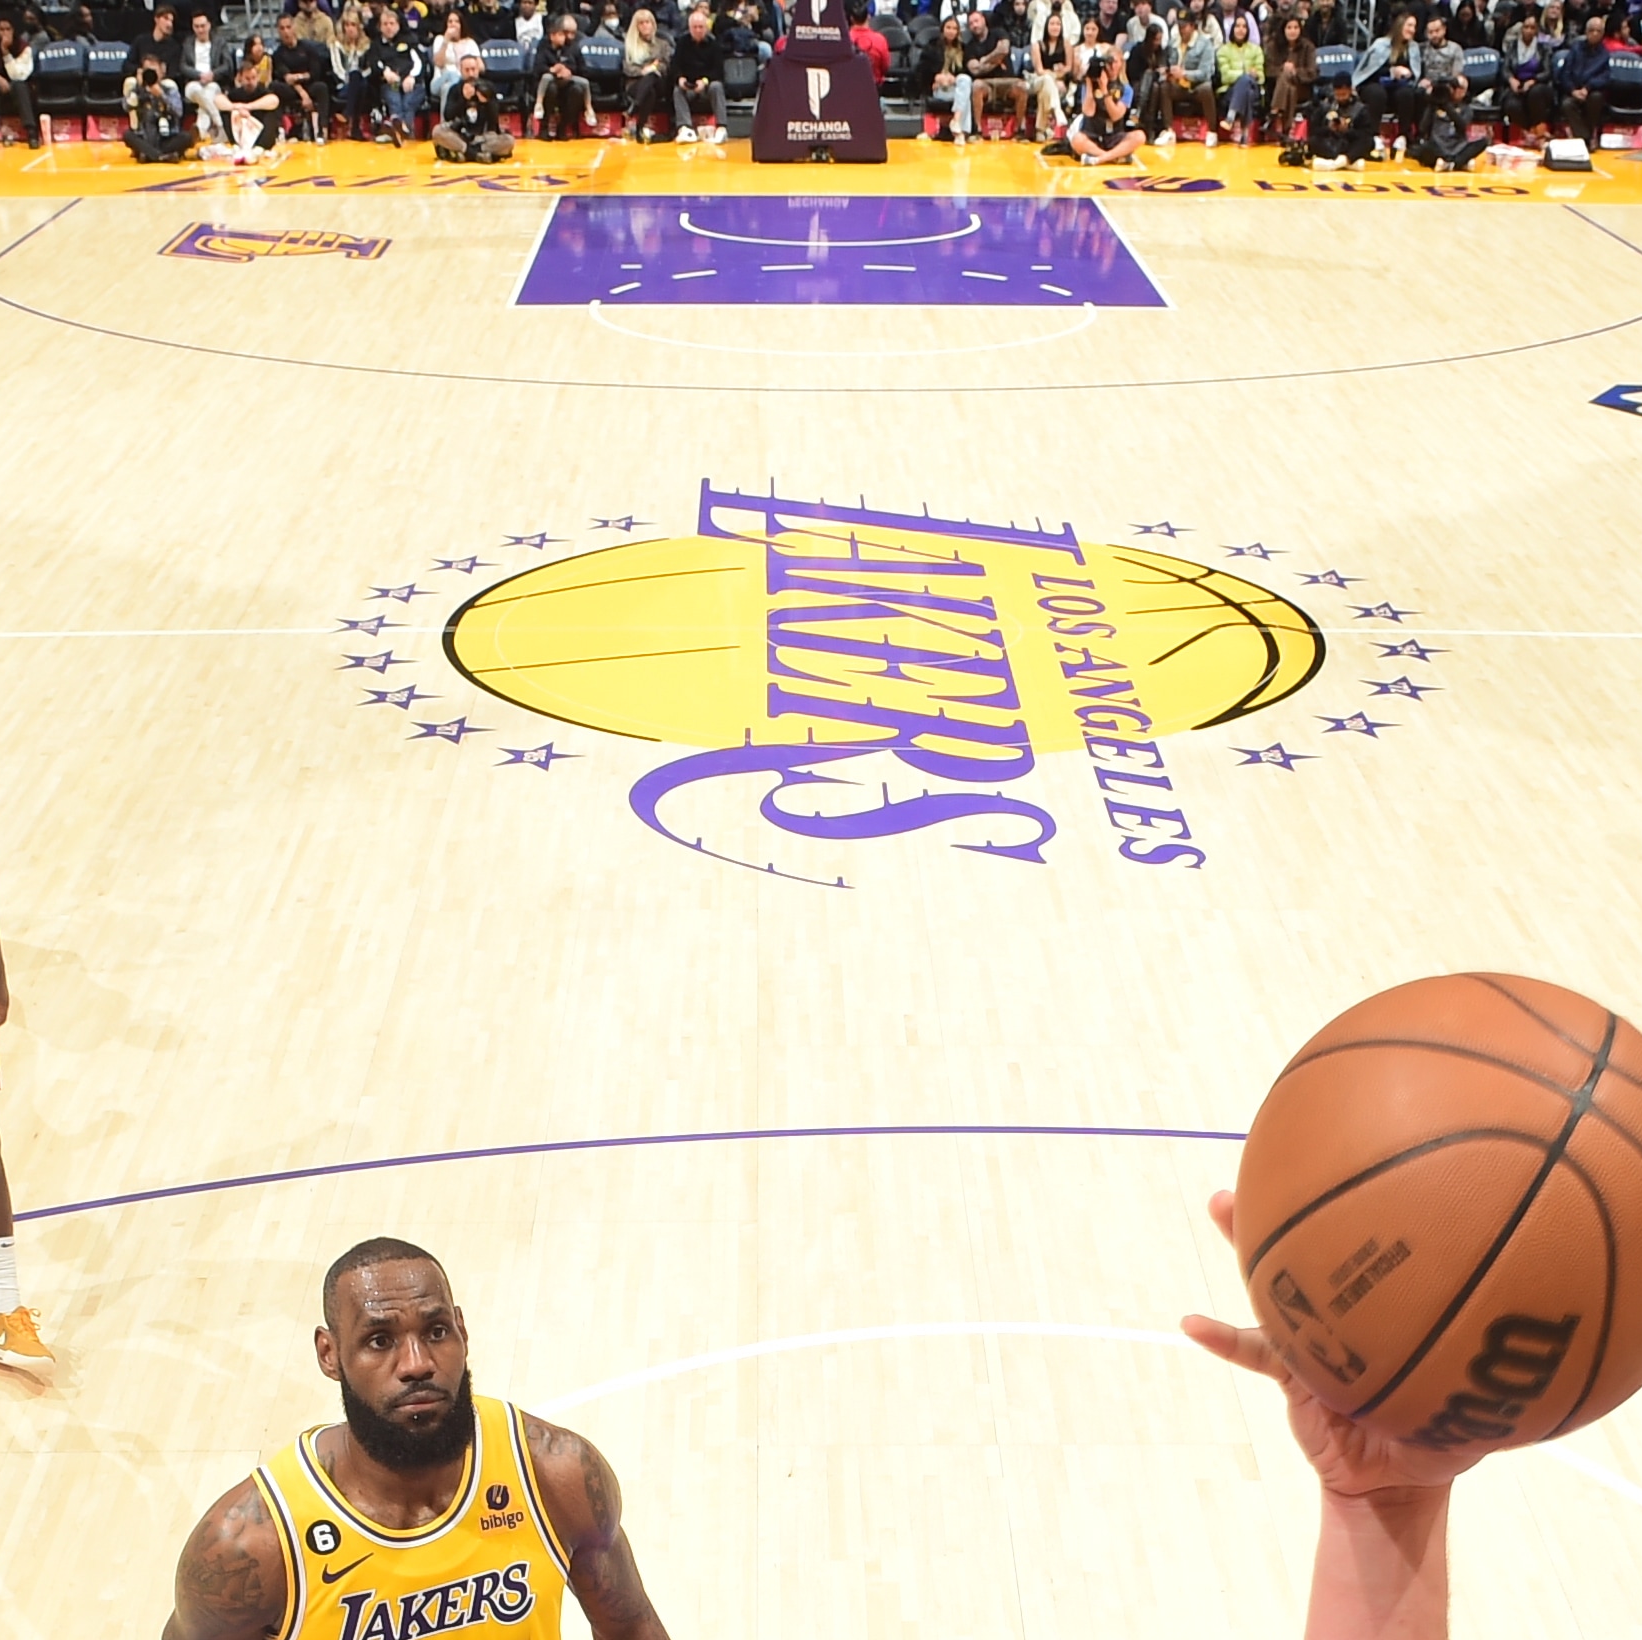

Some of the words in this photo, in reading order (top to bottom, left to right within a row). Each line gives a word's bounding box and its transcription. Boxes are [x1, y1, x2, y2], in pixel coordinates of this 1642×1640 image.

[795, 25, 840, 36] PECHANGA
[489, 48, 520, 58] DELTA
[1324, 52, 1355, 63] DELTA
[787, 121, 851, 133] PECHANGA
[787, 133, 818, 141] RESORT
[821, 133, 853, 141] CASINO
[1253, 178, 1530, 199] bibigo
[1031, 572, 1118, 640] LOS
[628, 476, 1085, 889] LAKERS
[1054, 642, 1207, 870] ANGELES
[479, 1511, 525, 1531] bibigo
[311, 1523, 337, 1552] 6
